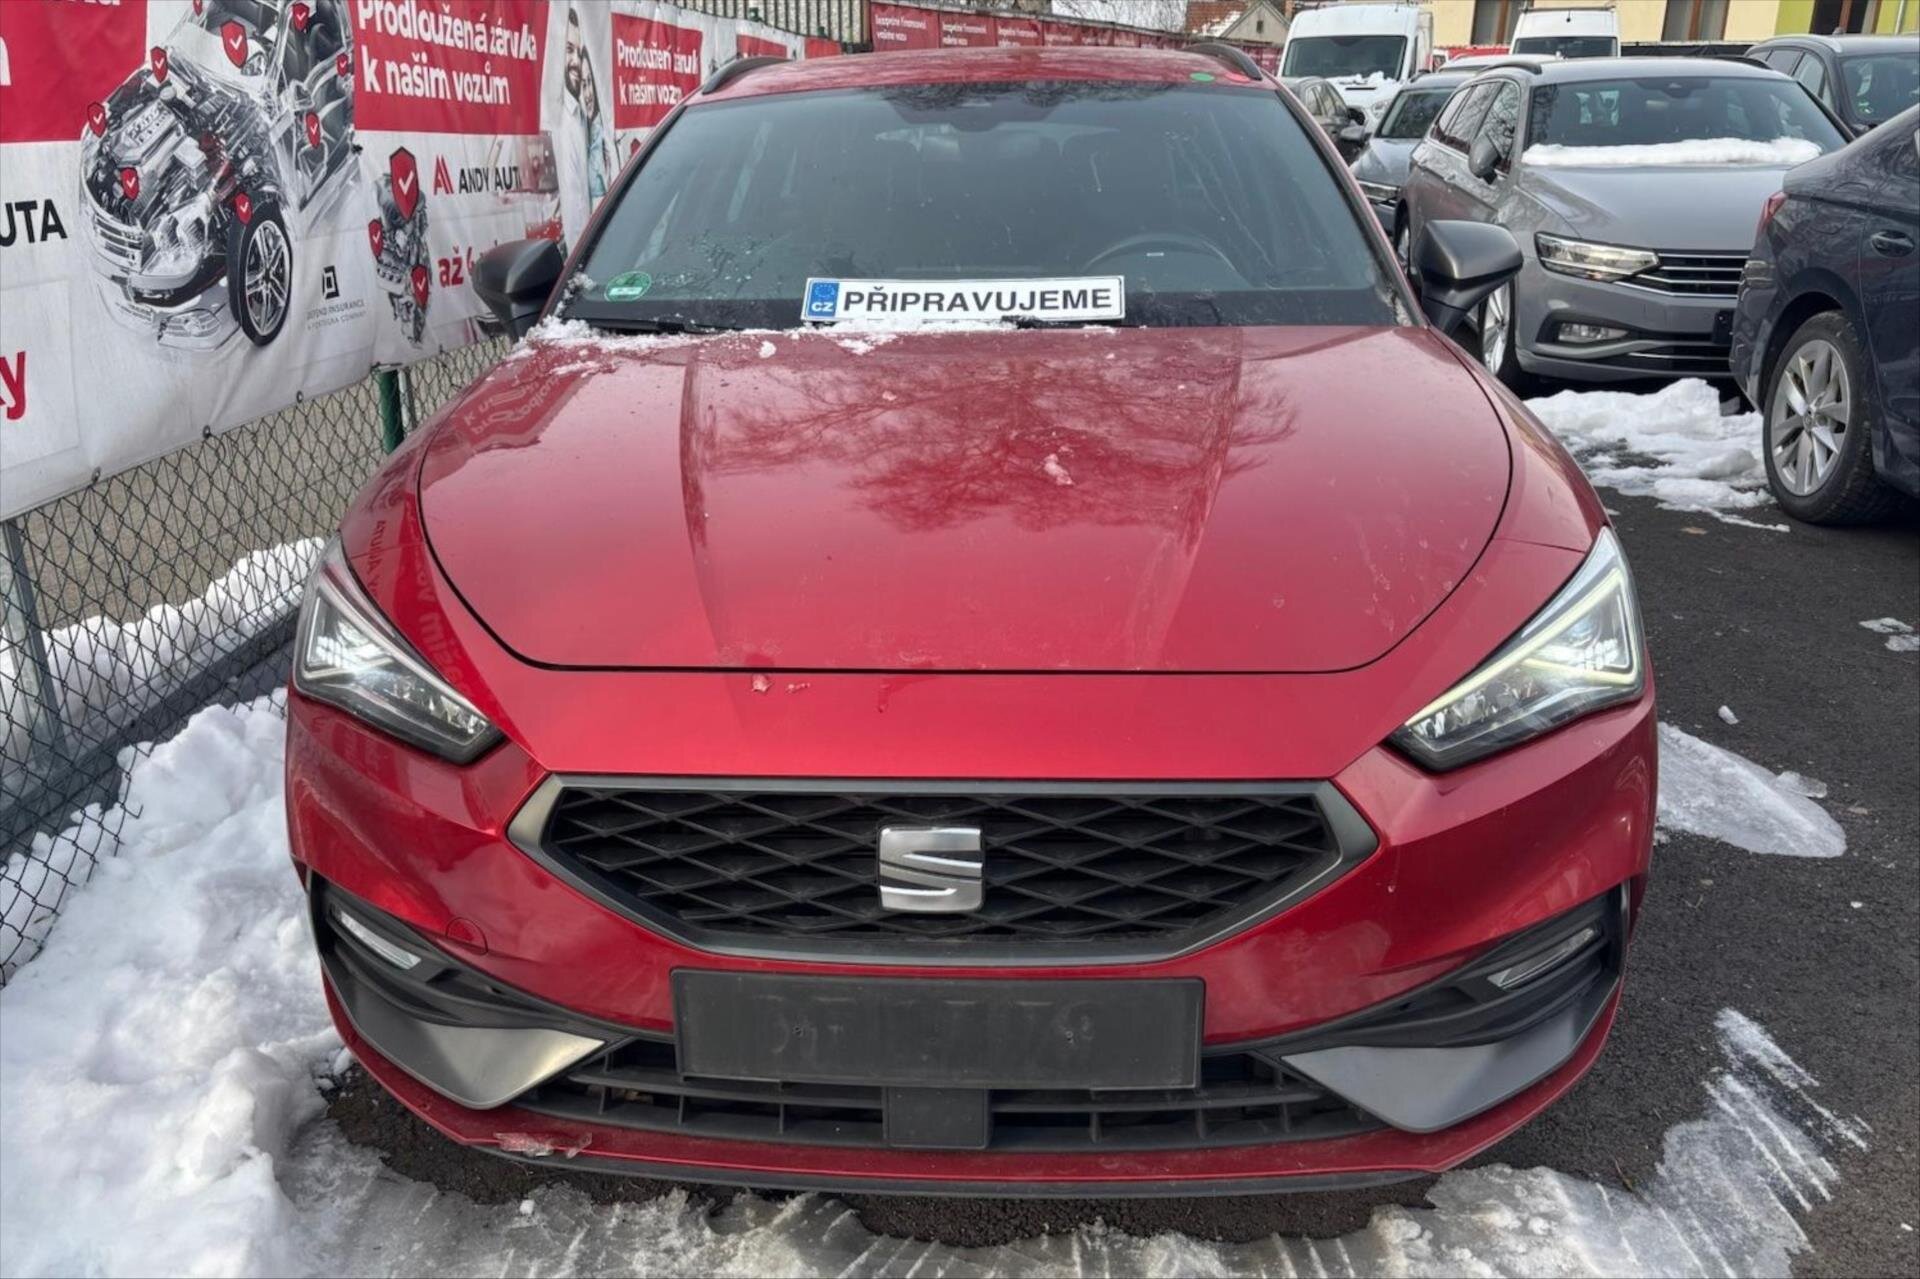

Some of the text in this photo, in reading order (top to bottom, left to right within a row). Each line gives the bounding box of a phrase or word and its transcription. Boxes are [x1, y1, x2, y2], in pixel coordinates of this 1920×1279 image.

[361, 45, 511, 105] k našim vozům
[459, 166, 521, 194] ANDY AUT
[438, 245, 464, 287] až
[811, 302, 834, 313] CZ
[843, 285, 1112, 312] PŘIPRAVUJEME
